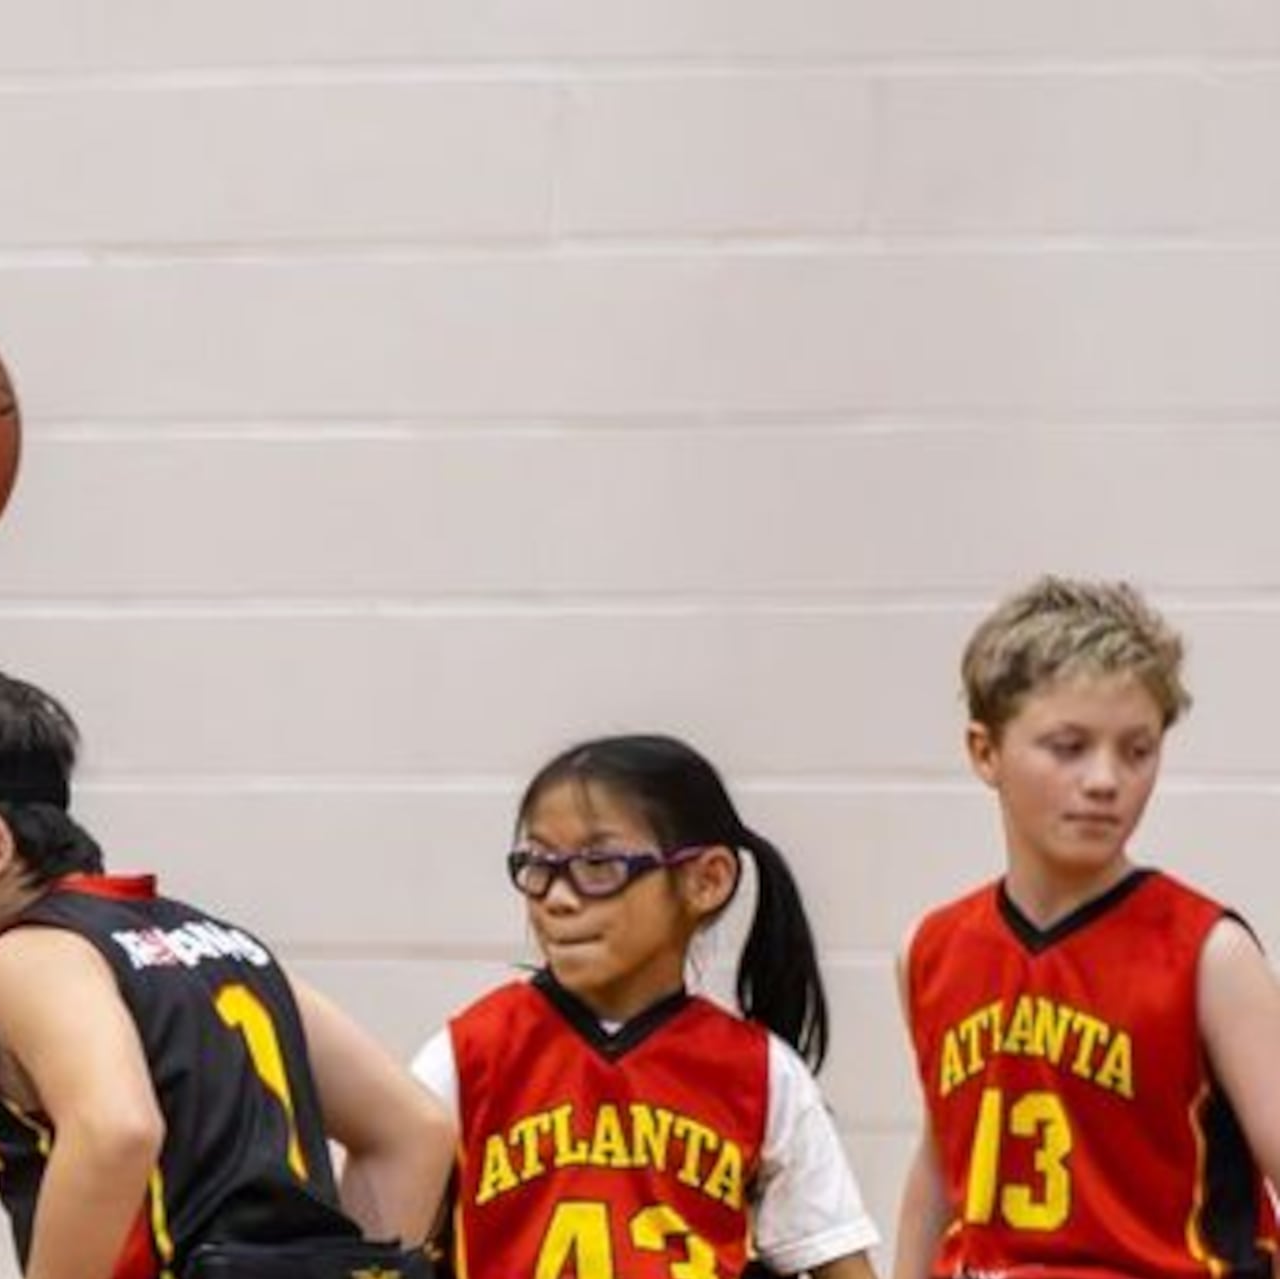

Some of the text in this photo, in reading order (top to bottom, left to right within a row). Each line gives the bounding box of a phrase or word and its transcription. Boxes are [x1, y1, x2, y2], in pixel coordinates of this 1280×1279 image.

[215, 983, 308, 1182] 1
[476, 1104, 742, 1209] ATLANTA
[965, 1087, 1072, 1231] 13
